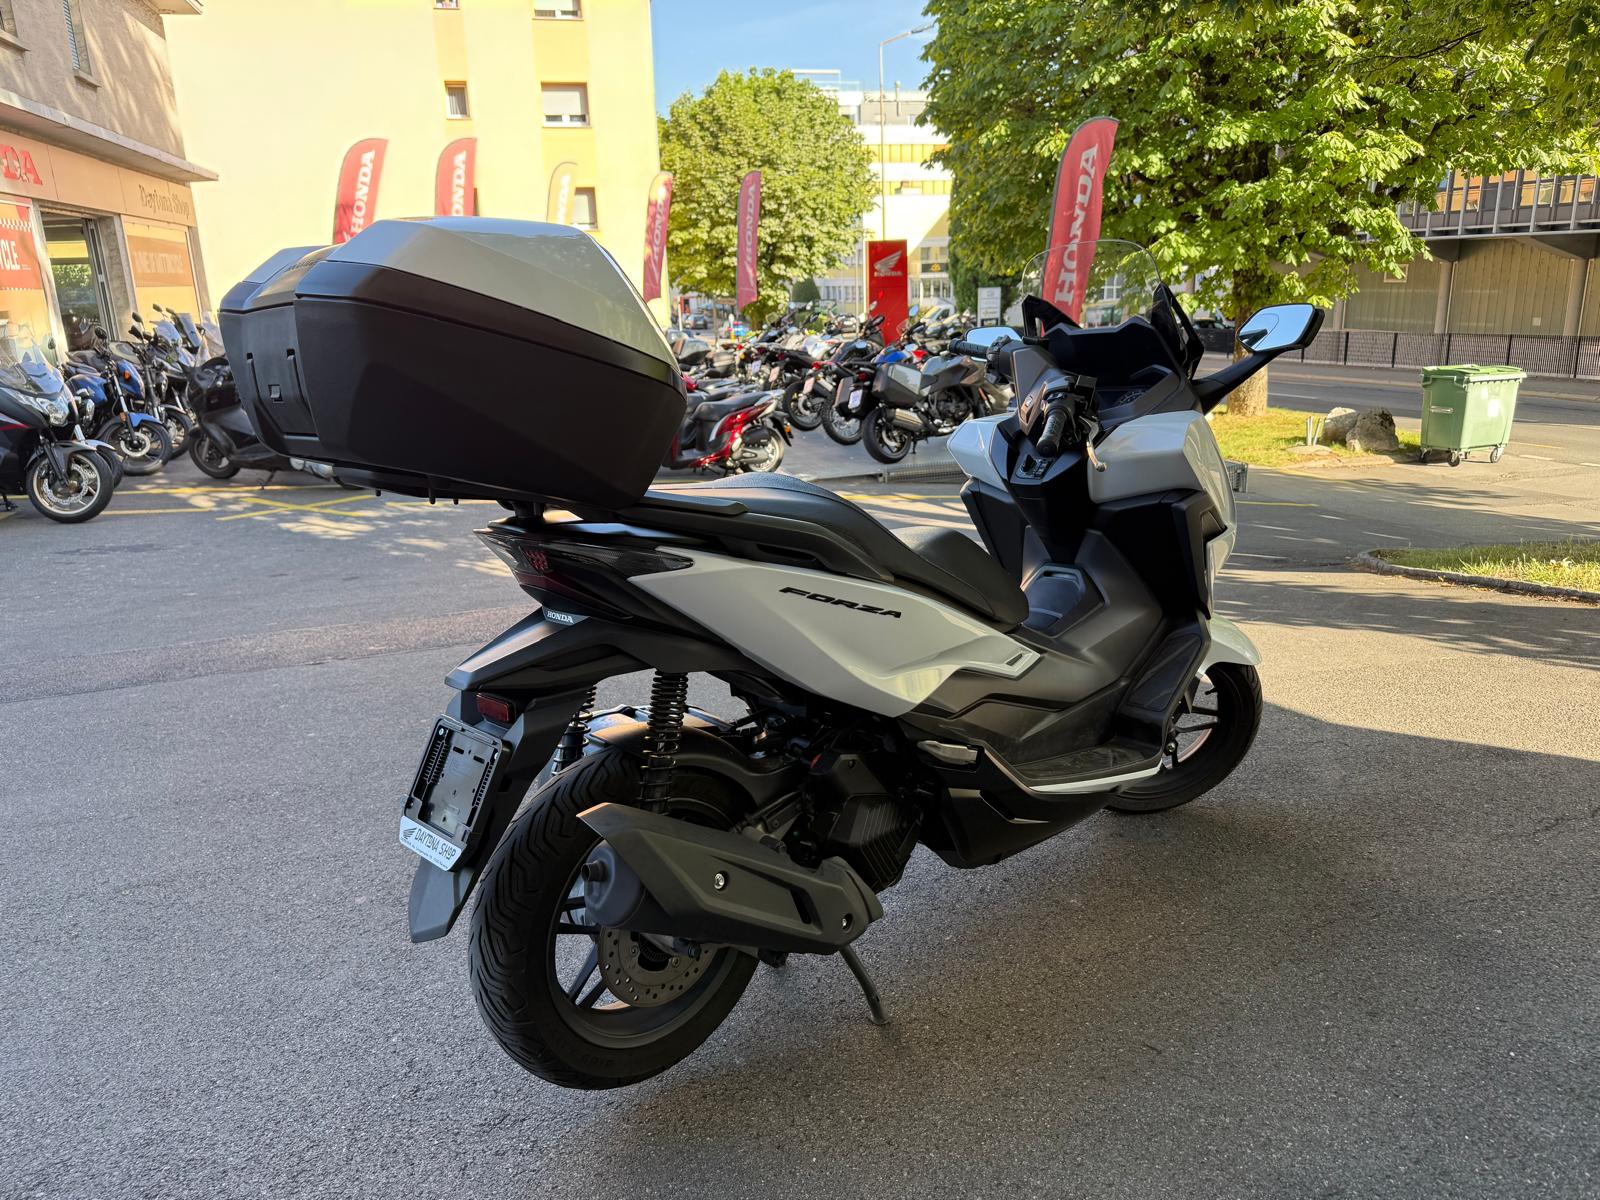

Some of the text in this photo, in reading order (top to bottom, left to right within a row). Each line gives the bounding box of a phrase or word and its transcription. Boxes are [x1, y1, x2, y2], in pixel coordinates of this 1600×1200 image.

[0, 144, 43, 186] DA
[351, 150, 375, 234] HONDA
[452, 150, 467, 216] ONDA
[745, 184, 755, 262] HONDA
[1055, 144, 1098, 306] HONDA
[547, 610, 574, 624] HONDA
[779, 587, 901, 618] FORZA
[415, 828, 440, 852] DAYTONA
[439, 842, 456, 860] SHOP
